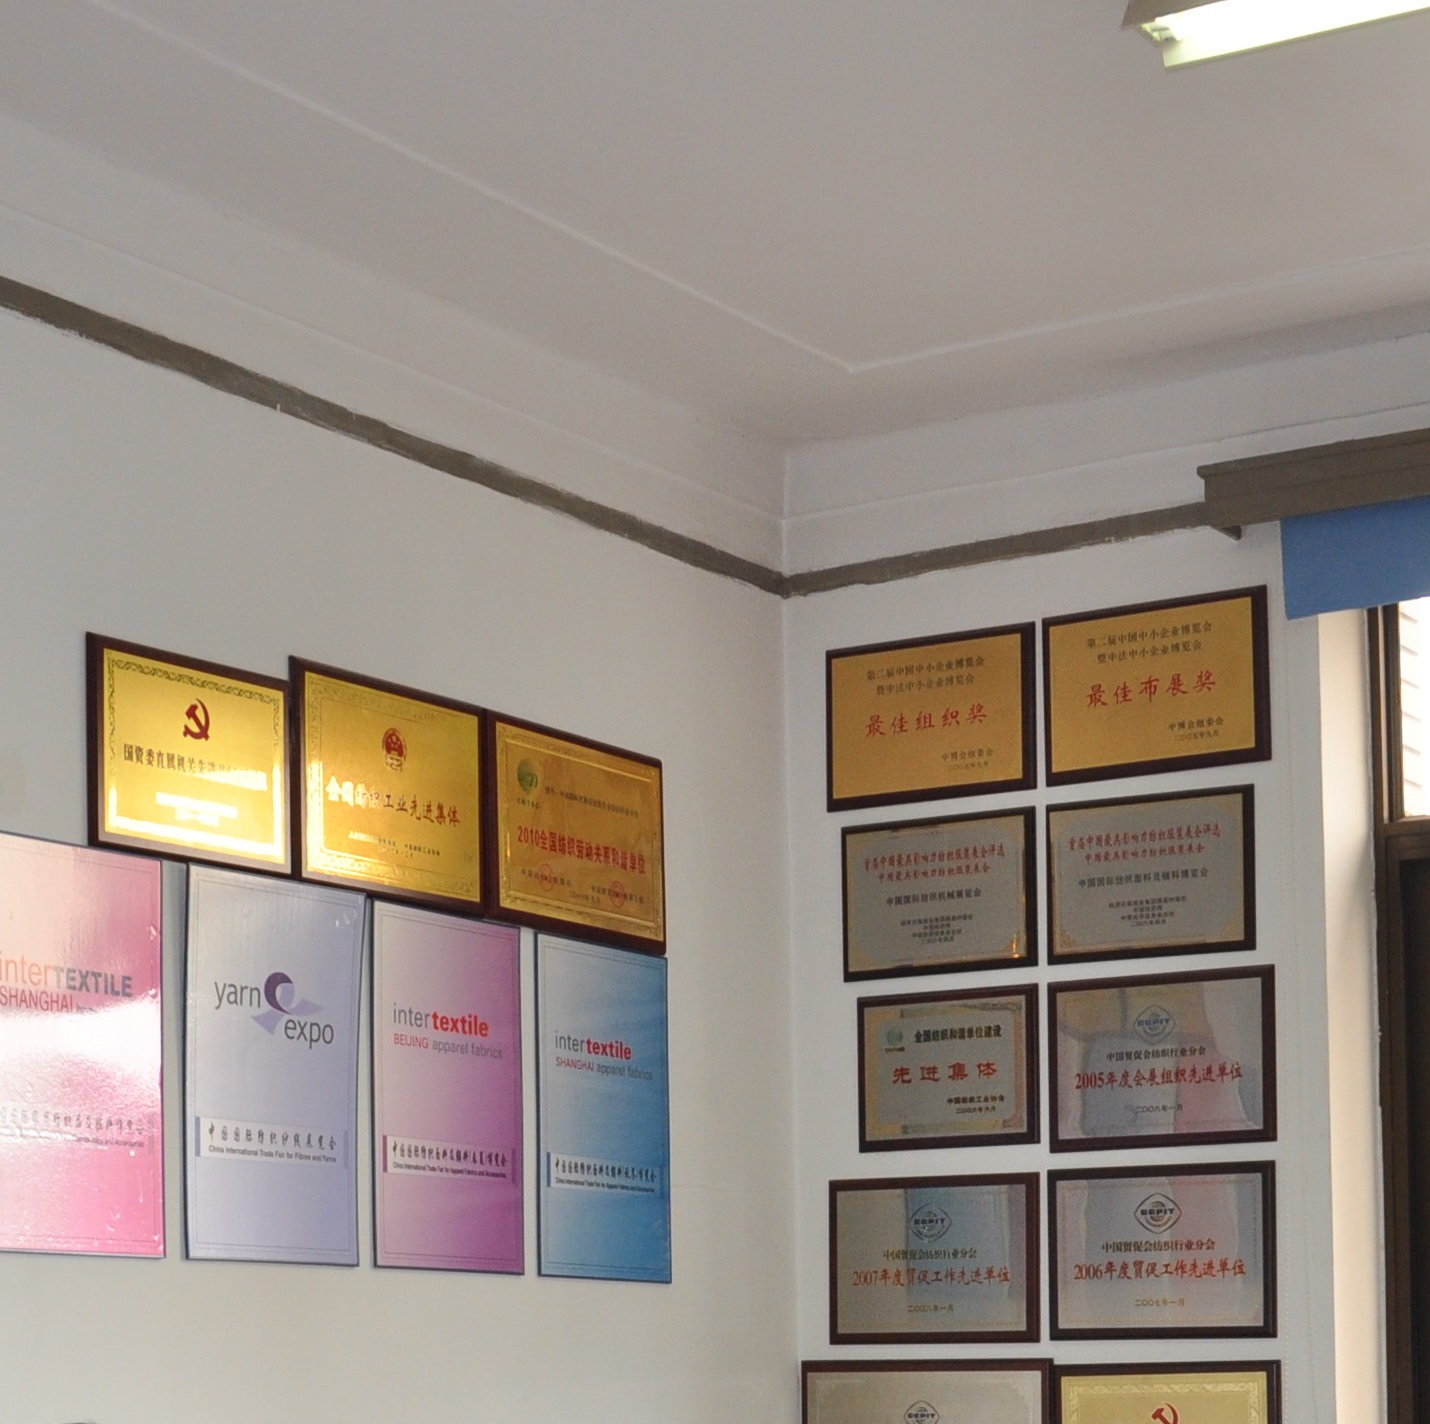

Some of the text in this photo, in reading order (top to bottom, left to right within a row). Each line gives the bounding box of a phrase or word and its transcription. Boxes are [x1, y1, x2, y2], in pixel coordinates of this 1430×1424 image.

[1086, 669, 1216, 708] 最佳布展奖
[866, 702, 987, 738] 最佳组织奖
[0, 985, 73, 1013] SHANGHAI
[215, 981, 261, 1010] yarn
[284, 1019, 334, 1049] expo
[393, 1033, 503, 1059] BEIJING apparel fabrics
[555, 1056, 653, 1081] SHANGHAI apparel fabrics
[892, 1062, 997, 1084] 先进集体
[1075, 1061, 1243, 1090] 2005年度会展组织先进单位
[208, 1144, 224, 1154] China
